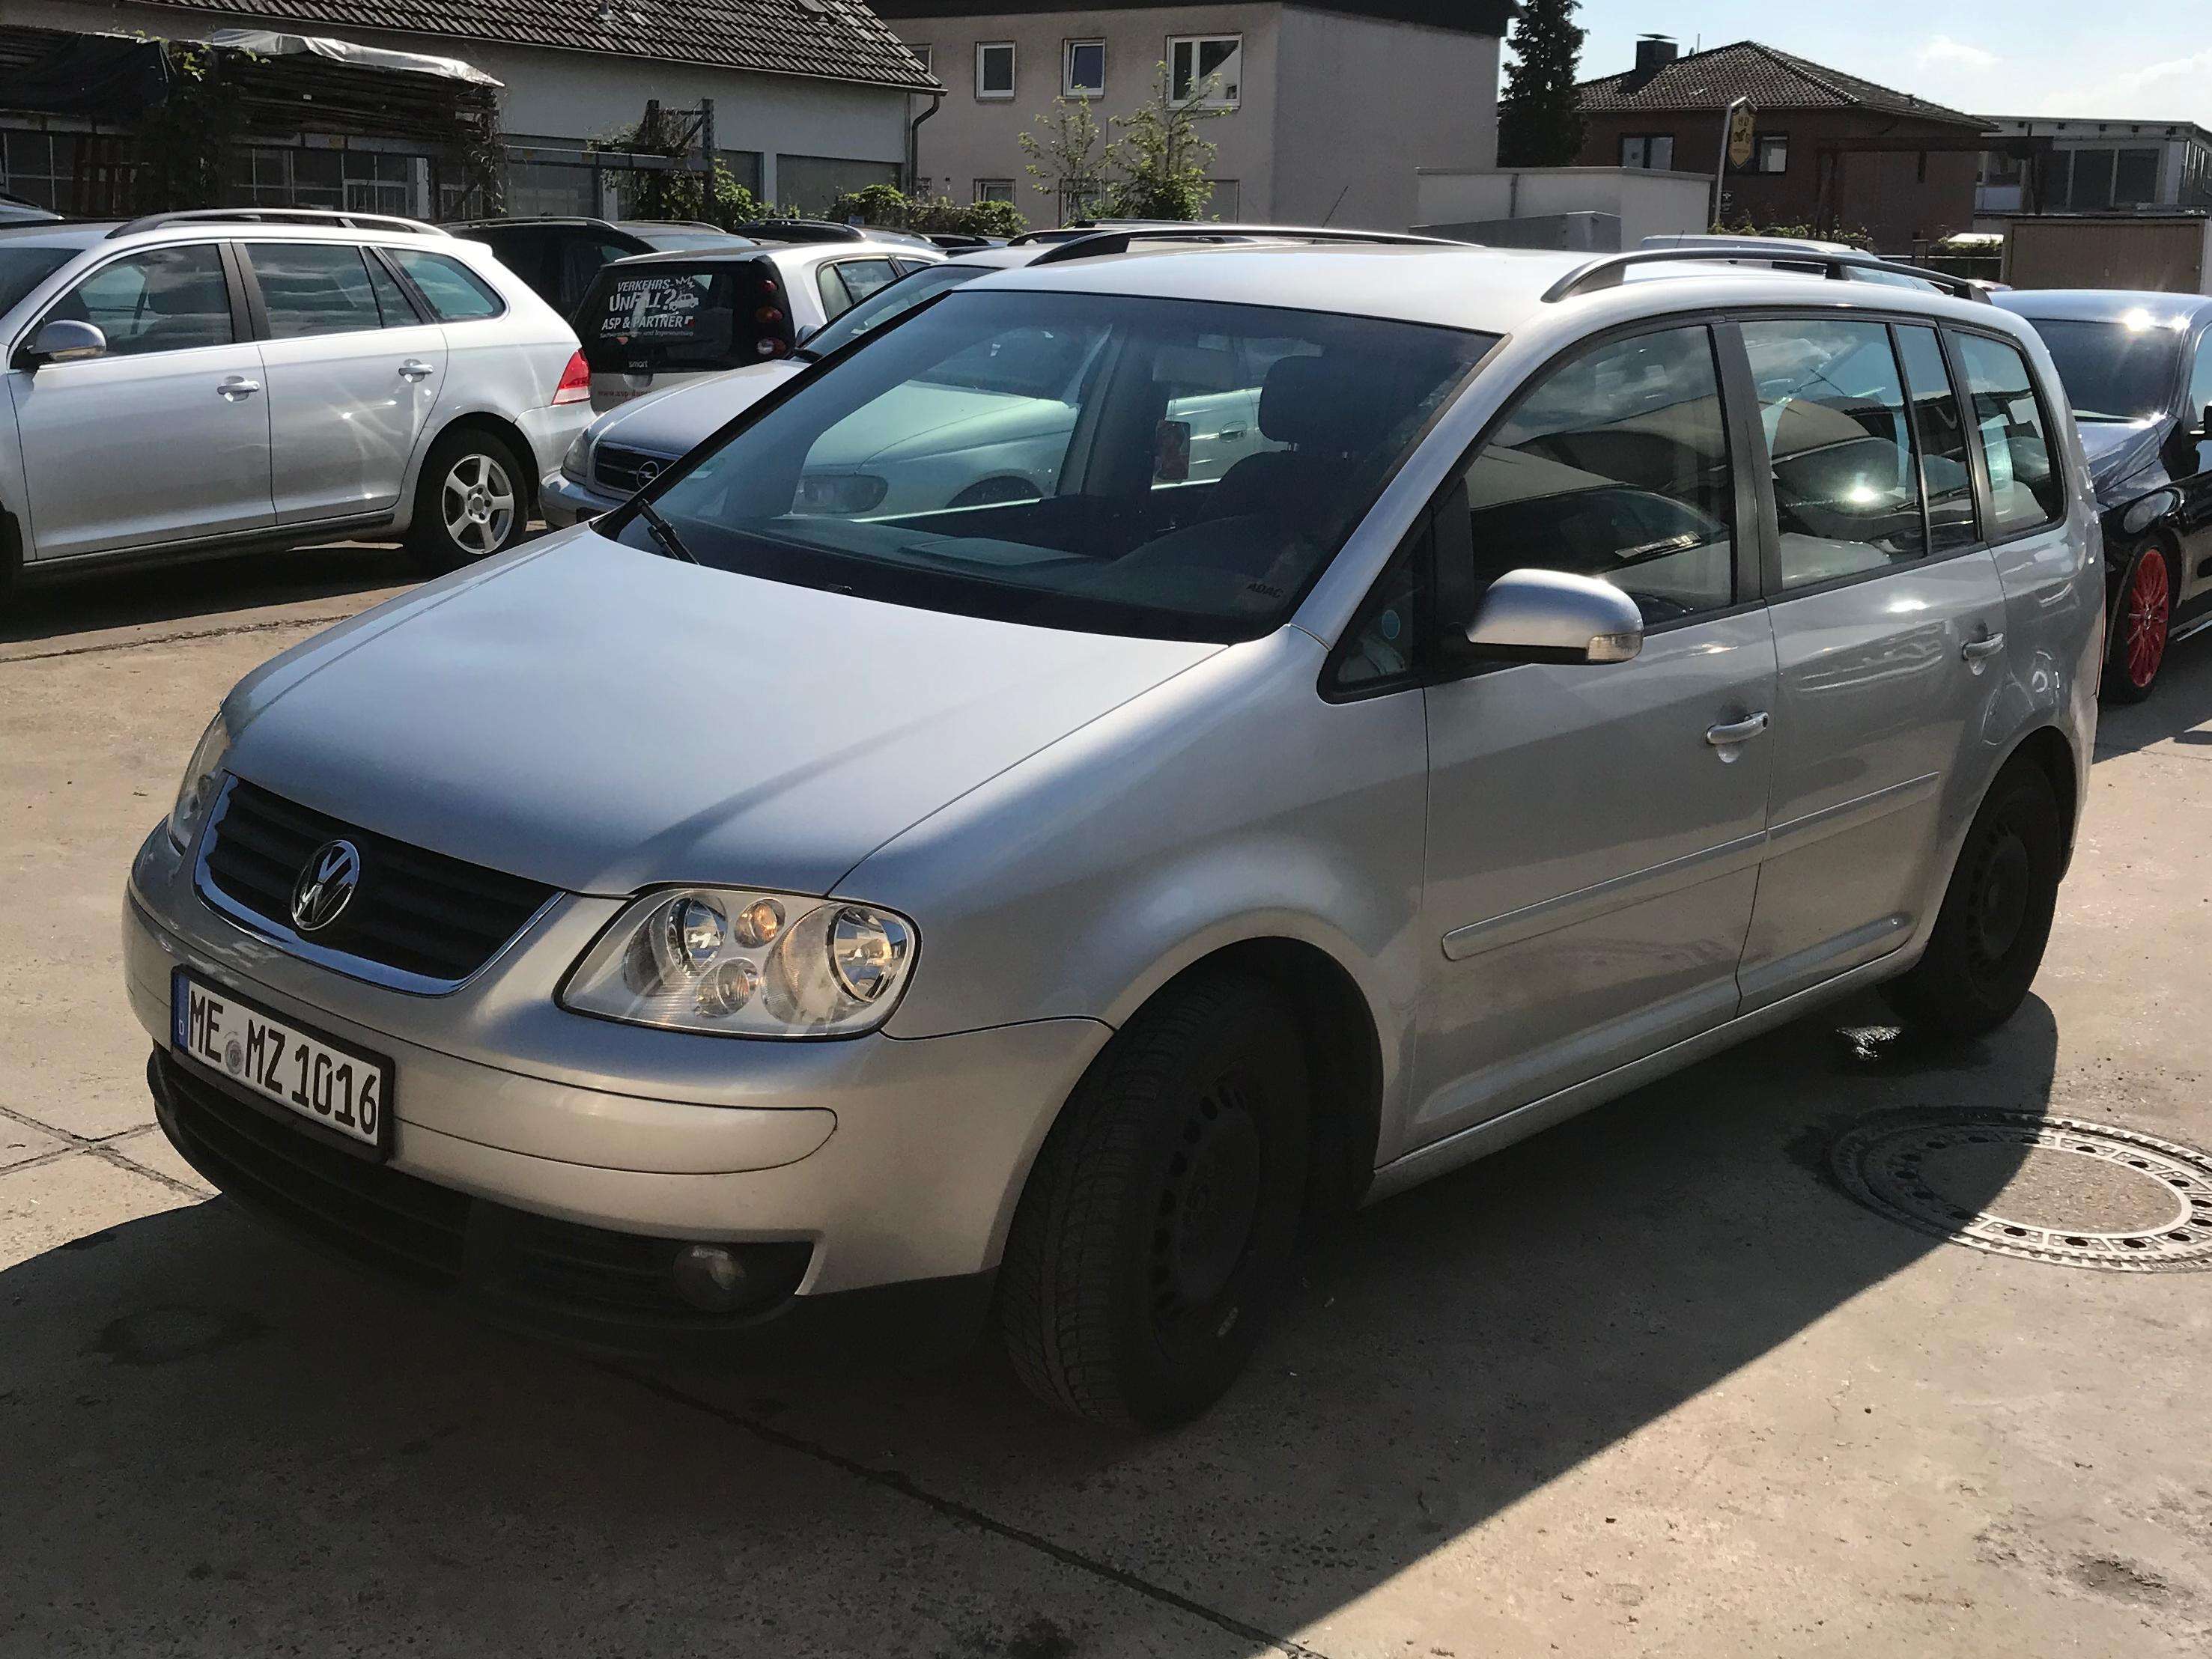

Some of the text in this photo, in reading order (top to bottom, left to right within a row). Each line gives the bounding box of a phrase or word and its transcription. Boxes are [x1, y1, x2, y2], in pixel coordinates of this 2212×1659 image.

[618, 278, 674, 292] VERKEHRS-
[601, 314, 682, 330] ASP & PARTNER
[1246, 583, 1283, 598] ADAC
[178, 1020, 185, 1036] D
[189, 990, 377, 1135] ME MZ 1016
